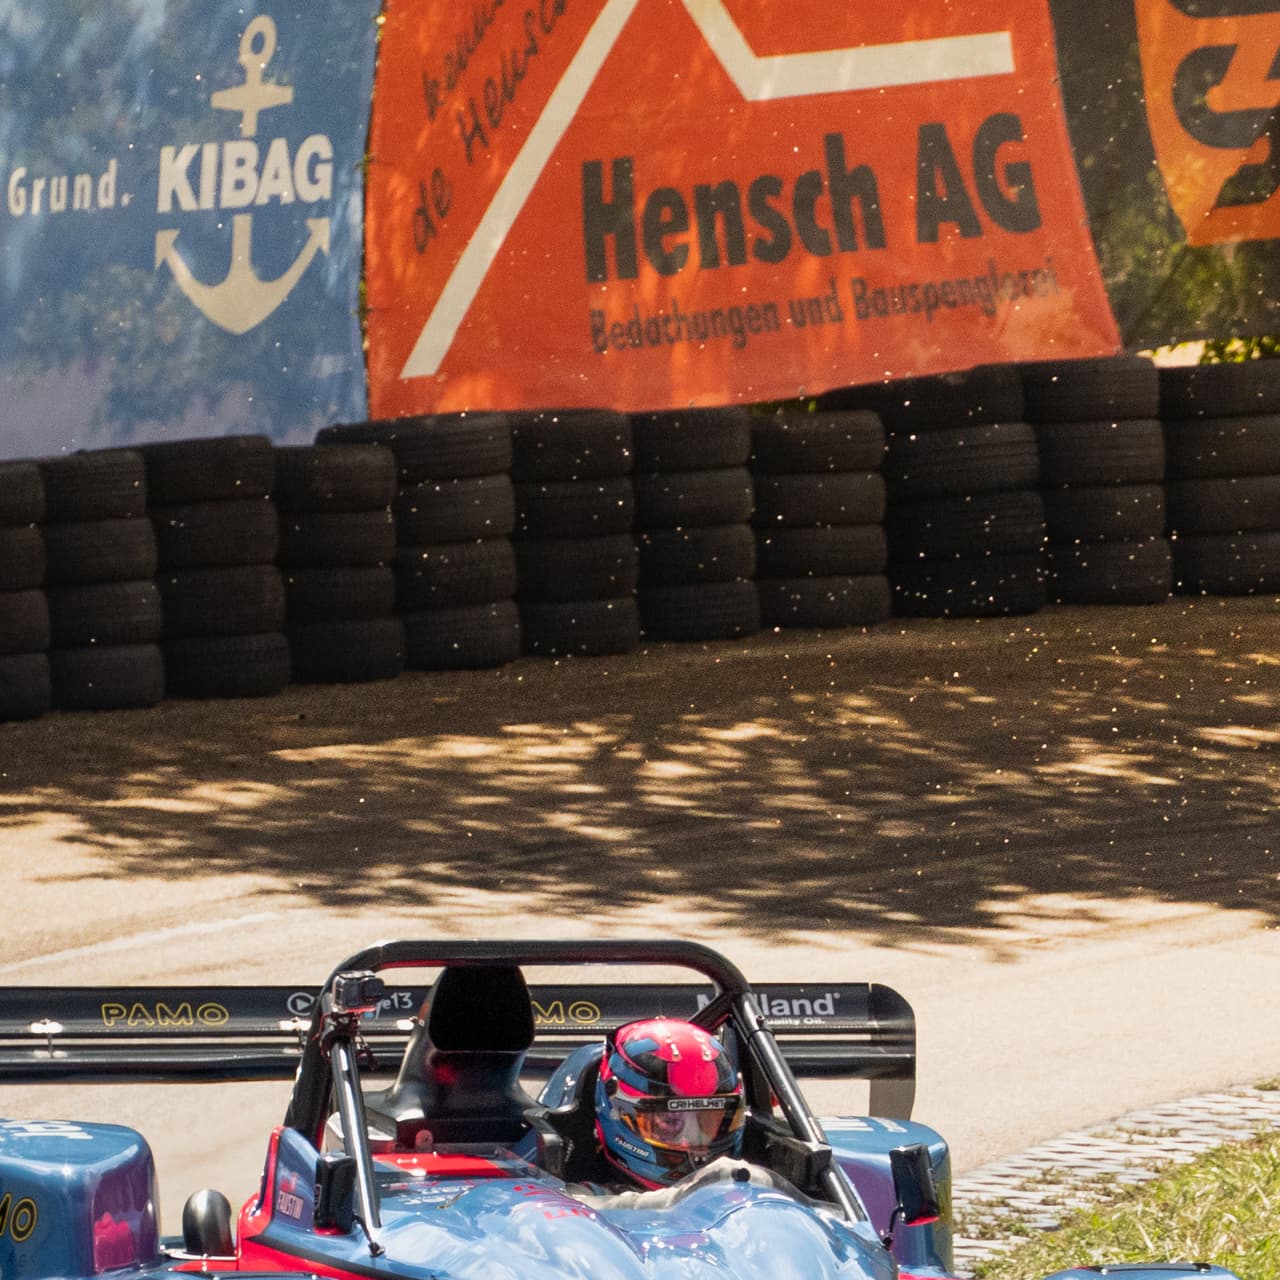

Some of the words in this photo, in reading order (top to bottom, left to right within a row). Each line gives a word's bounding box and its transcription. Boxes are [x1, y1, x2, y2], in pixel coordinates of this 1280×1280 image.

[7, 158, 133, 218] Grund.
[156, 132, 334, 214] KIBAG
[580, 132, 886, 285] Hensch
[916, 111, 1043, 245] AG
[590, 298, 781, 353] Bedachungen
[787, 277, 842, 328] und
[852, 256, 1059, 321] Bauspenglerei
[101, 1002, 230, 1027] PAMO
[532, 1000, 600, 1024] MO
[766, 1017, 800, 1026] uality
